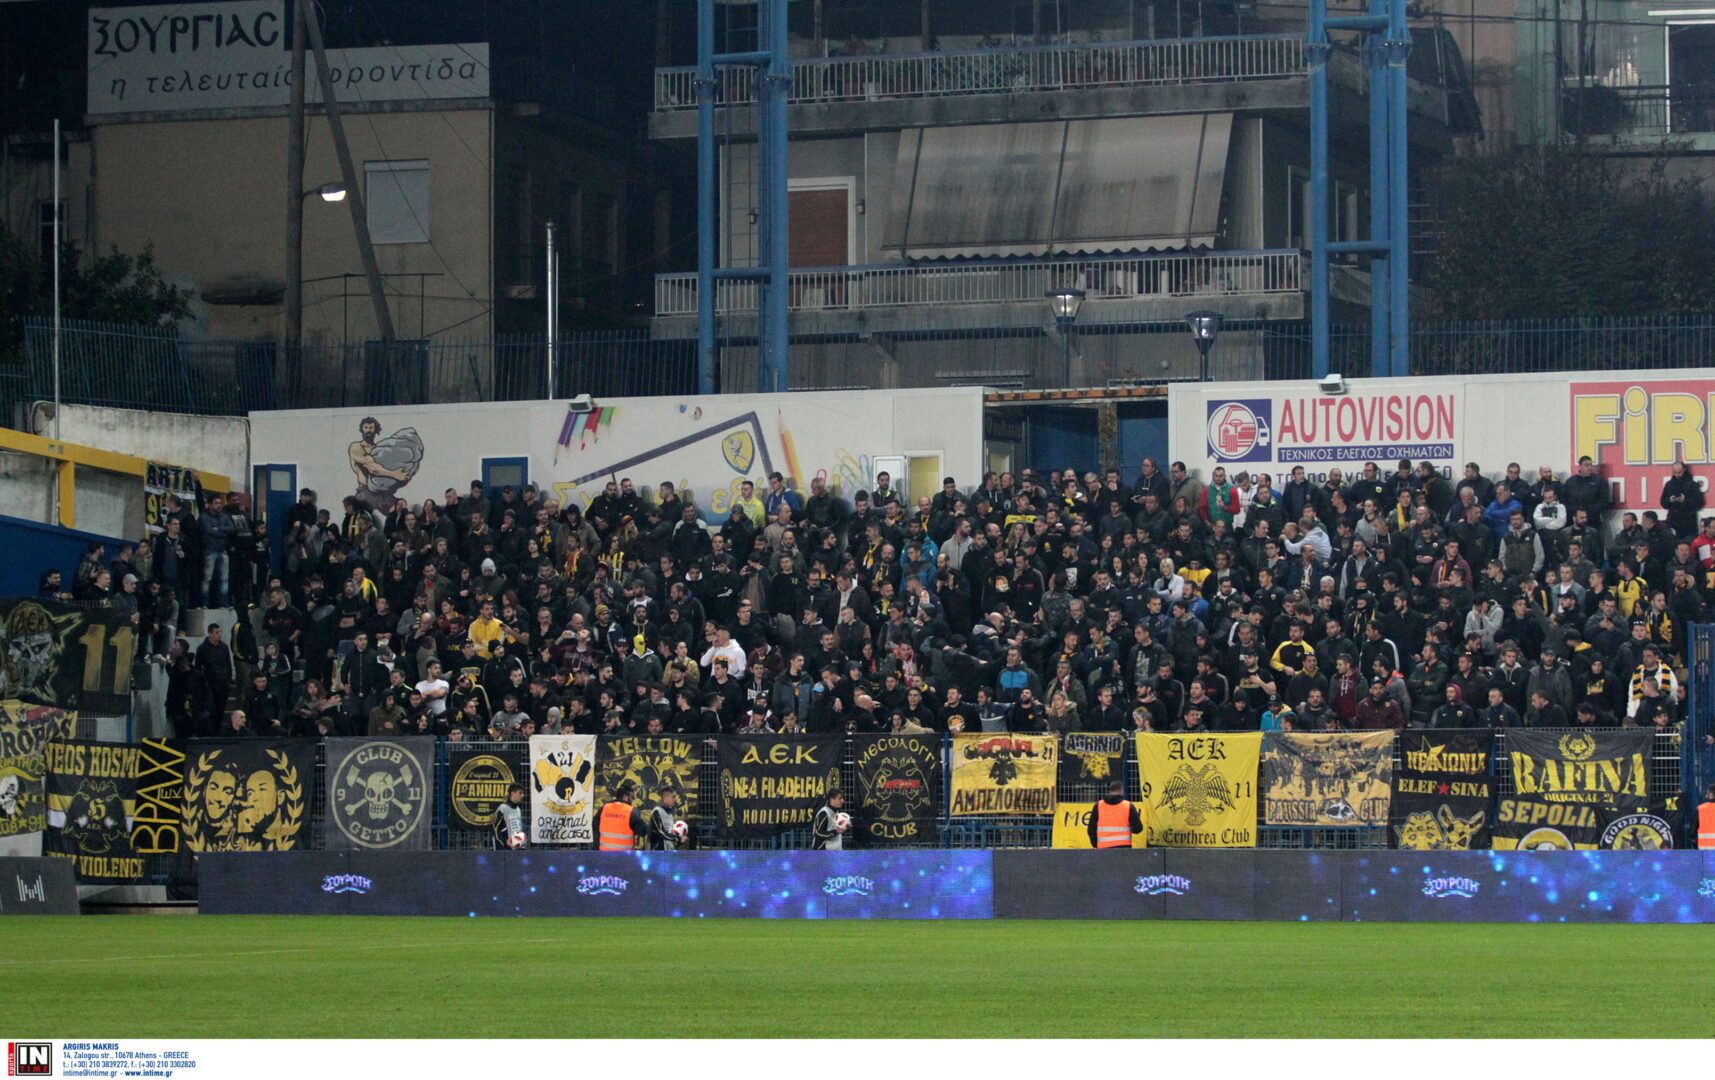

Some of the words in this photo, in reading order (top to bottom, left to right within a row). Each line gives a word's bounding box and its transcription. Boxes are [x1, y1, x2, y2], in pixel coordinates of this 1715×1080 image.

[110, 79, 126, 101] η
[1278, 395, 1454, 443] AUTOVISION
[1281, 447, 1333, 461] ΤΕΧΝΙΚΟΣ
[1337, 446, 1384, 459] ΕΛΕΓΧΟΣ
[1387, 445, 1452, 459] ΟΧΗΜΑΤΩΝ
[79, 624, 133, 694] 11
[356, 747, 404, 765] CLUB
[607, 737, 693, 759] YELLOW
[557, 752, 574, 768] 21
[1511, 751, 1647, 797] RAFINA
[408, 788, 422, 801] 11
[761, 776, 826, 800] FILADELFIA
[742, 808, 814, 825] HOOLIGANS
[349, 818, 407, 842] GETTO
[870, 822, 918, 839] CLUB
[1221, 826, 1250, 844] Club
